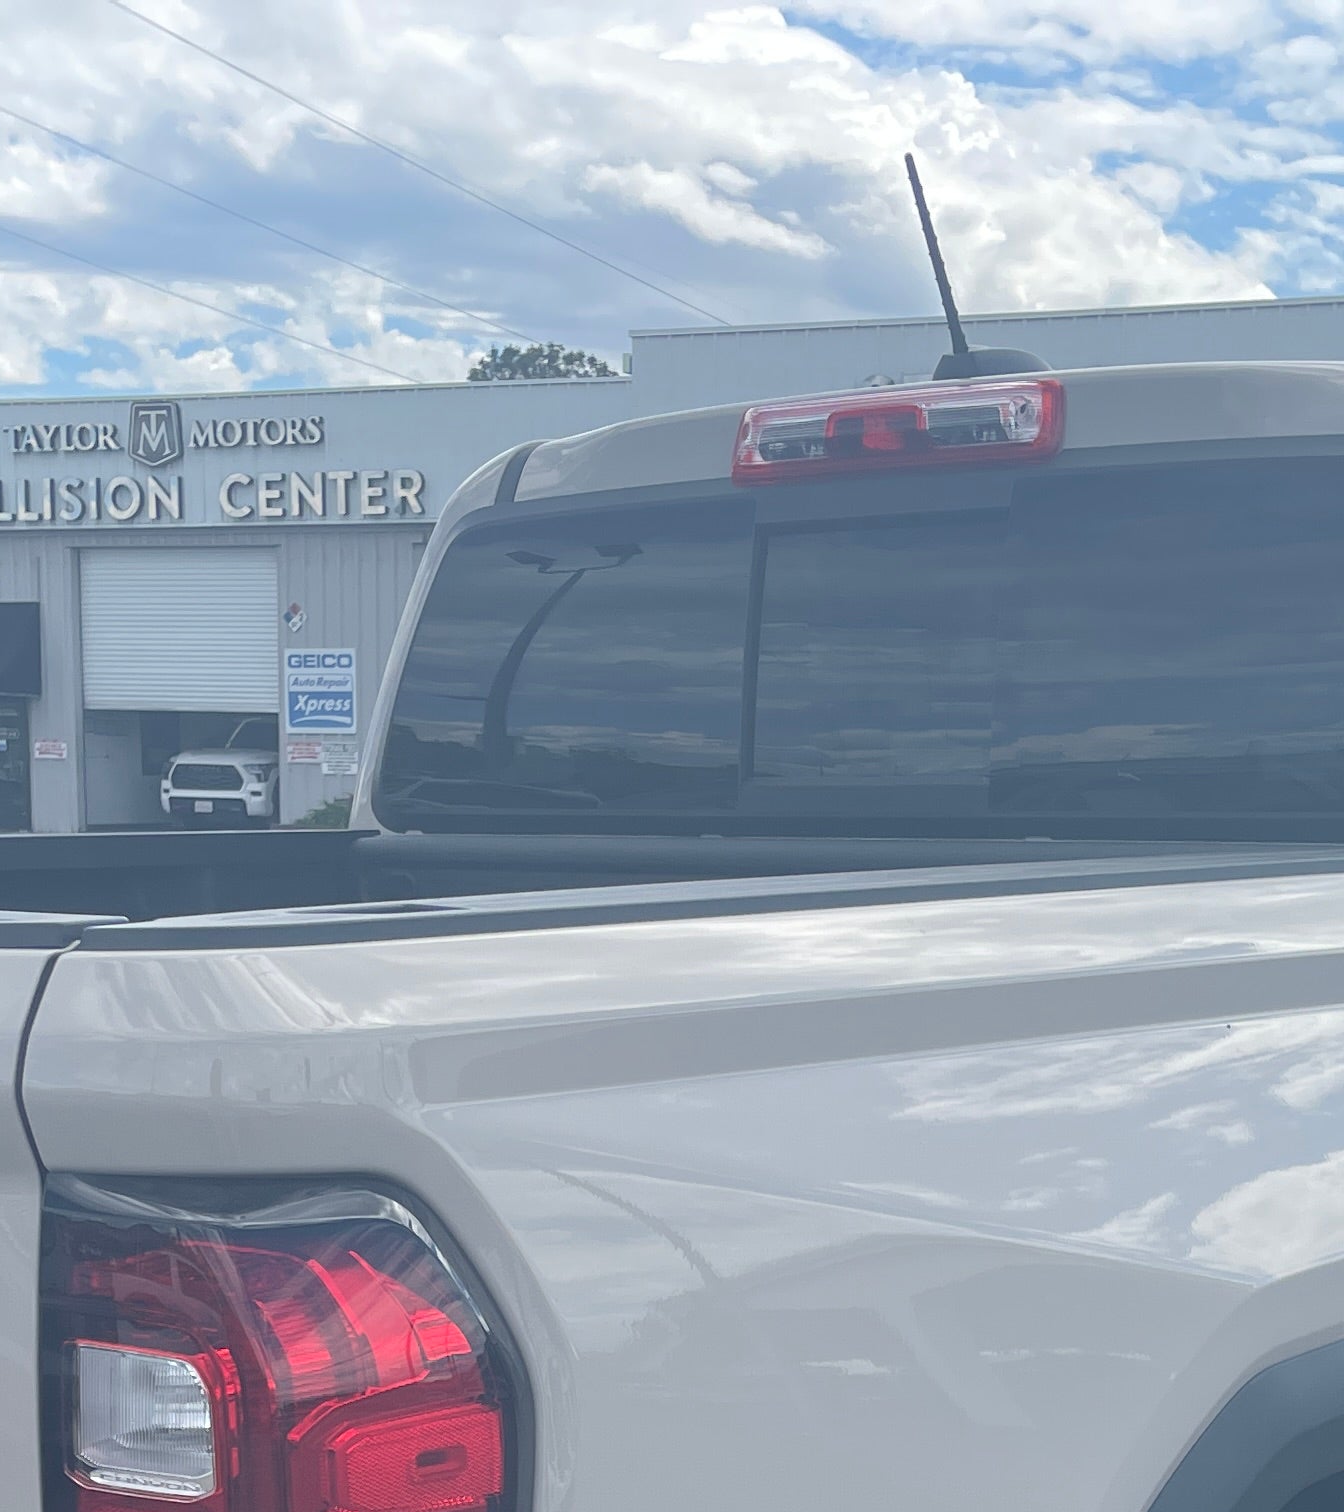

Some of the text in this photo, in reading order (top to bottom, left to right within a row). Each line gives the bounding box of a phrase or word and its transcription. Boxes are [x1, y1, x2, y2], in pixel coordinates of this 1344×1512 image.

[3, 415, 325, 454] TAYLOR MOTORS
[218, 468, 426, 519] CENTER
[287, 653, 353, 669] GEICO
[291, 677, 350, 689] Auto Repair
[294, 694, 352, 716] Xpress
